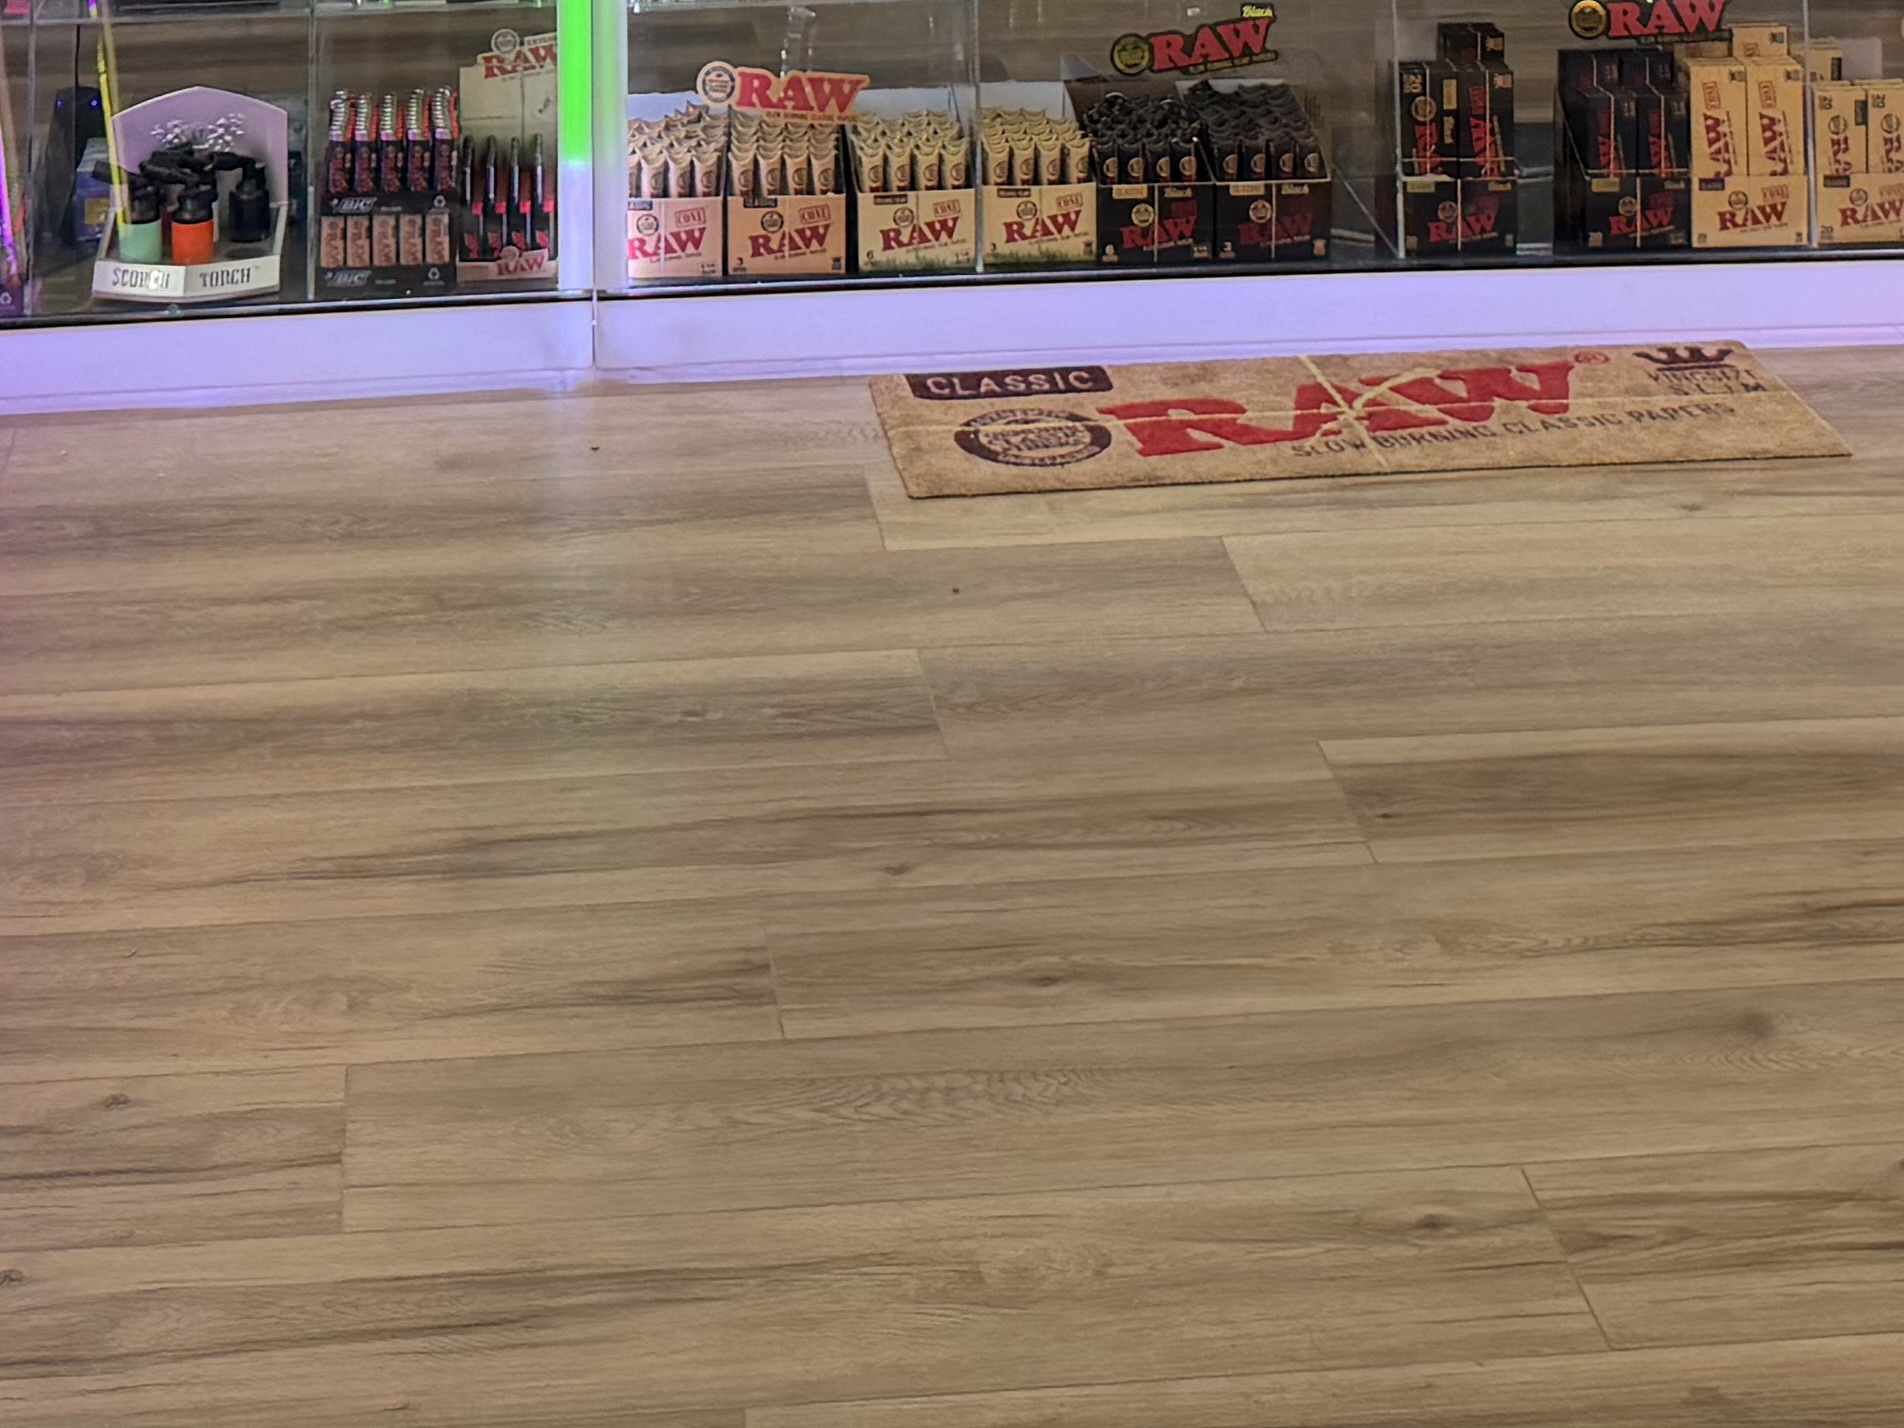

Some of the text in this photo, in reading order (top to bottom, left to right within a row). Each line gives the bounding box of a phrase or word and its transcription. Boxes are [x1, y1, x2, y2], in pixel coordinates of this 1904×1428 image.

[1152, 18, 1272, 70] RAW
[736, 72, 859, 113] RAW
[880, 216, 960, 251] RAW
[1717, 201, 1787, 231] RAW
[112, 266, 252, 289] SCORH TORCH
[926, 368, 1095, 395] CLASSIC
[1096, 360, 1576, 458] RAW
[1291, 402, 1736, 459] SLOW BURNING CLASSIC PAPERS
